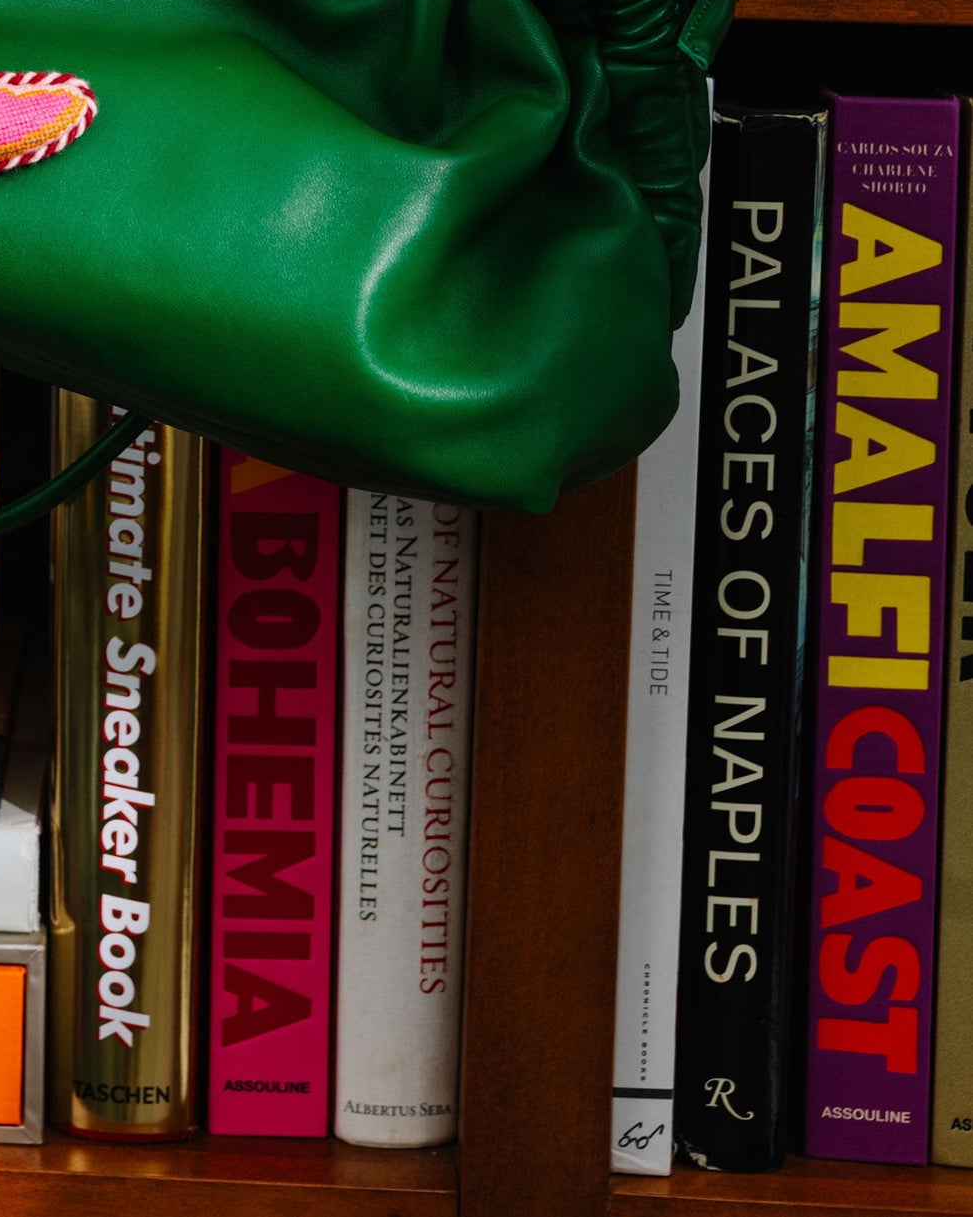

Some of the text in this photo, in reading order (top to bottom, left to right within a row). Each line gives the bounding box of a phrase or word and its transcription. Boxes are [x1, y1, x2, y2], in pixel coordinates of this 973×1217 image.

[837, 142, 954, 157] CARLOS SOUZA
[852, 163, 938, 177] CHARLENE
[861, 181, 927, 194] SHORTO
[427, 558, 459, 739] NATURAL
[649, 569, 672, 696] TIME & TIDE
[704, 201, 784, 983] PALACES OF NAPLES
[817, 202, 943, 1075] AMALFI COAST
[97, 406, 161, 1048] timate Sneaker Book
[359, 493, 389, 922] NET DES CURIOSITÉS NATURELLES
[388, 498, 418, 837] AS NATURALIENKABINETT
[221, 511, 322, 1048] BOHEMIA
[419, 747, 456, 995] CURIOSITIES
[640, 963, 651, 1081] CHRONICLE BOOKS
[73, 1081, 171, 1104] TASCHEN
[223, 1079, 311, 1094] ASSOULINE
[821, 1105, 911, 1124] ASSOULINE
[950, 1117, 973, 1131] AS
